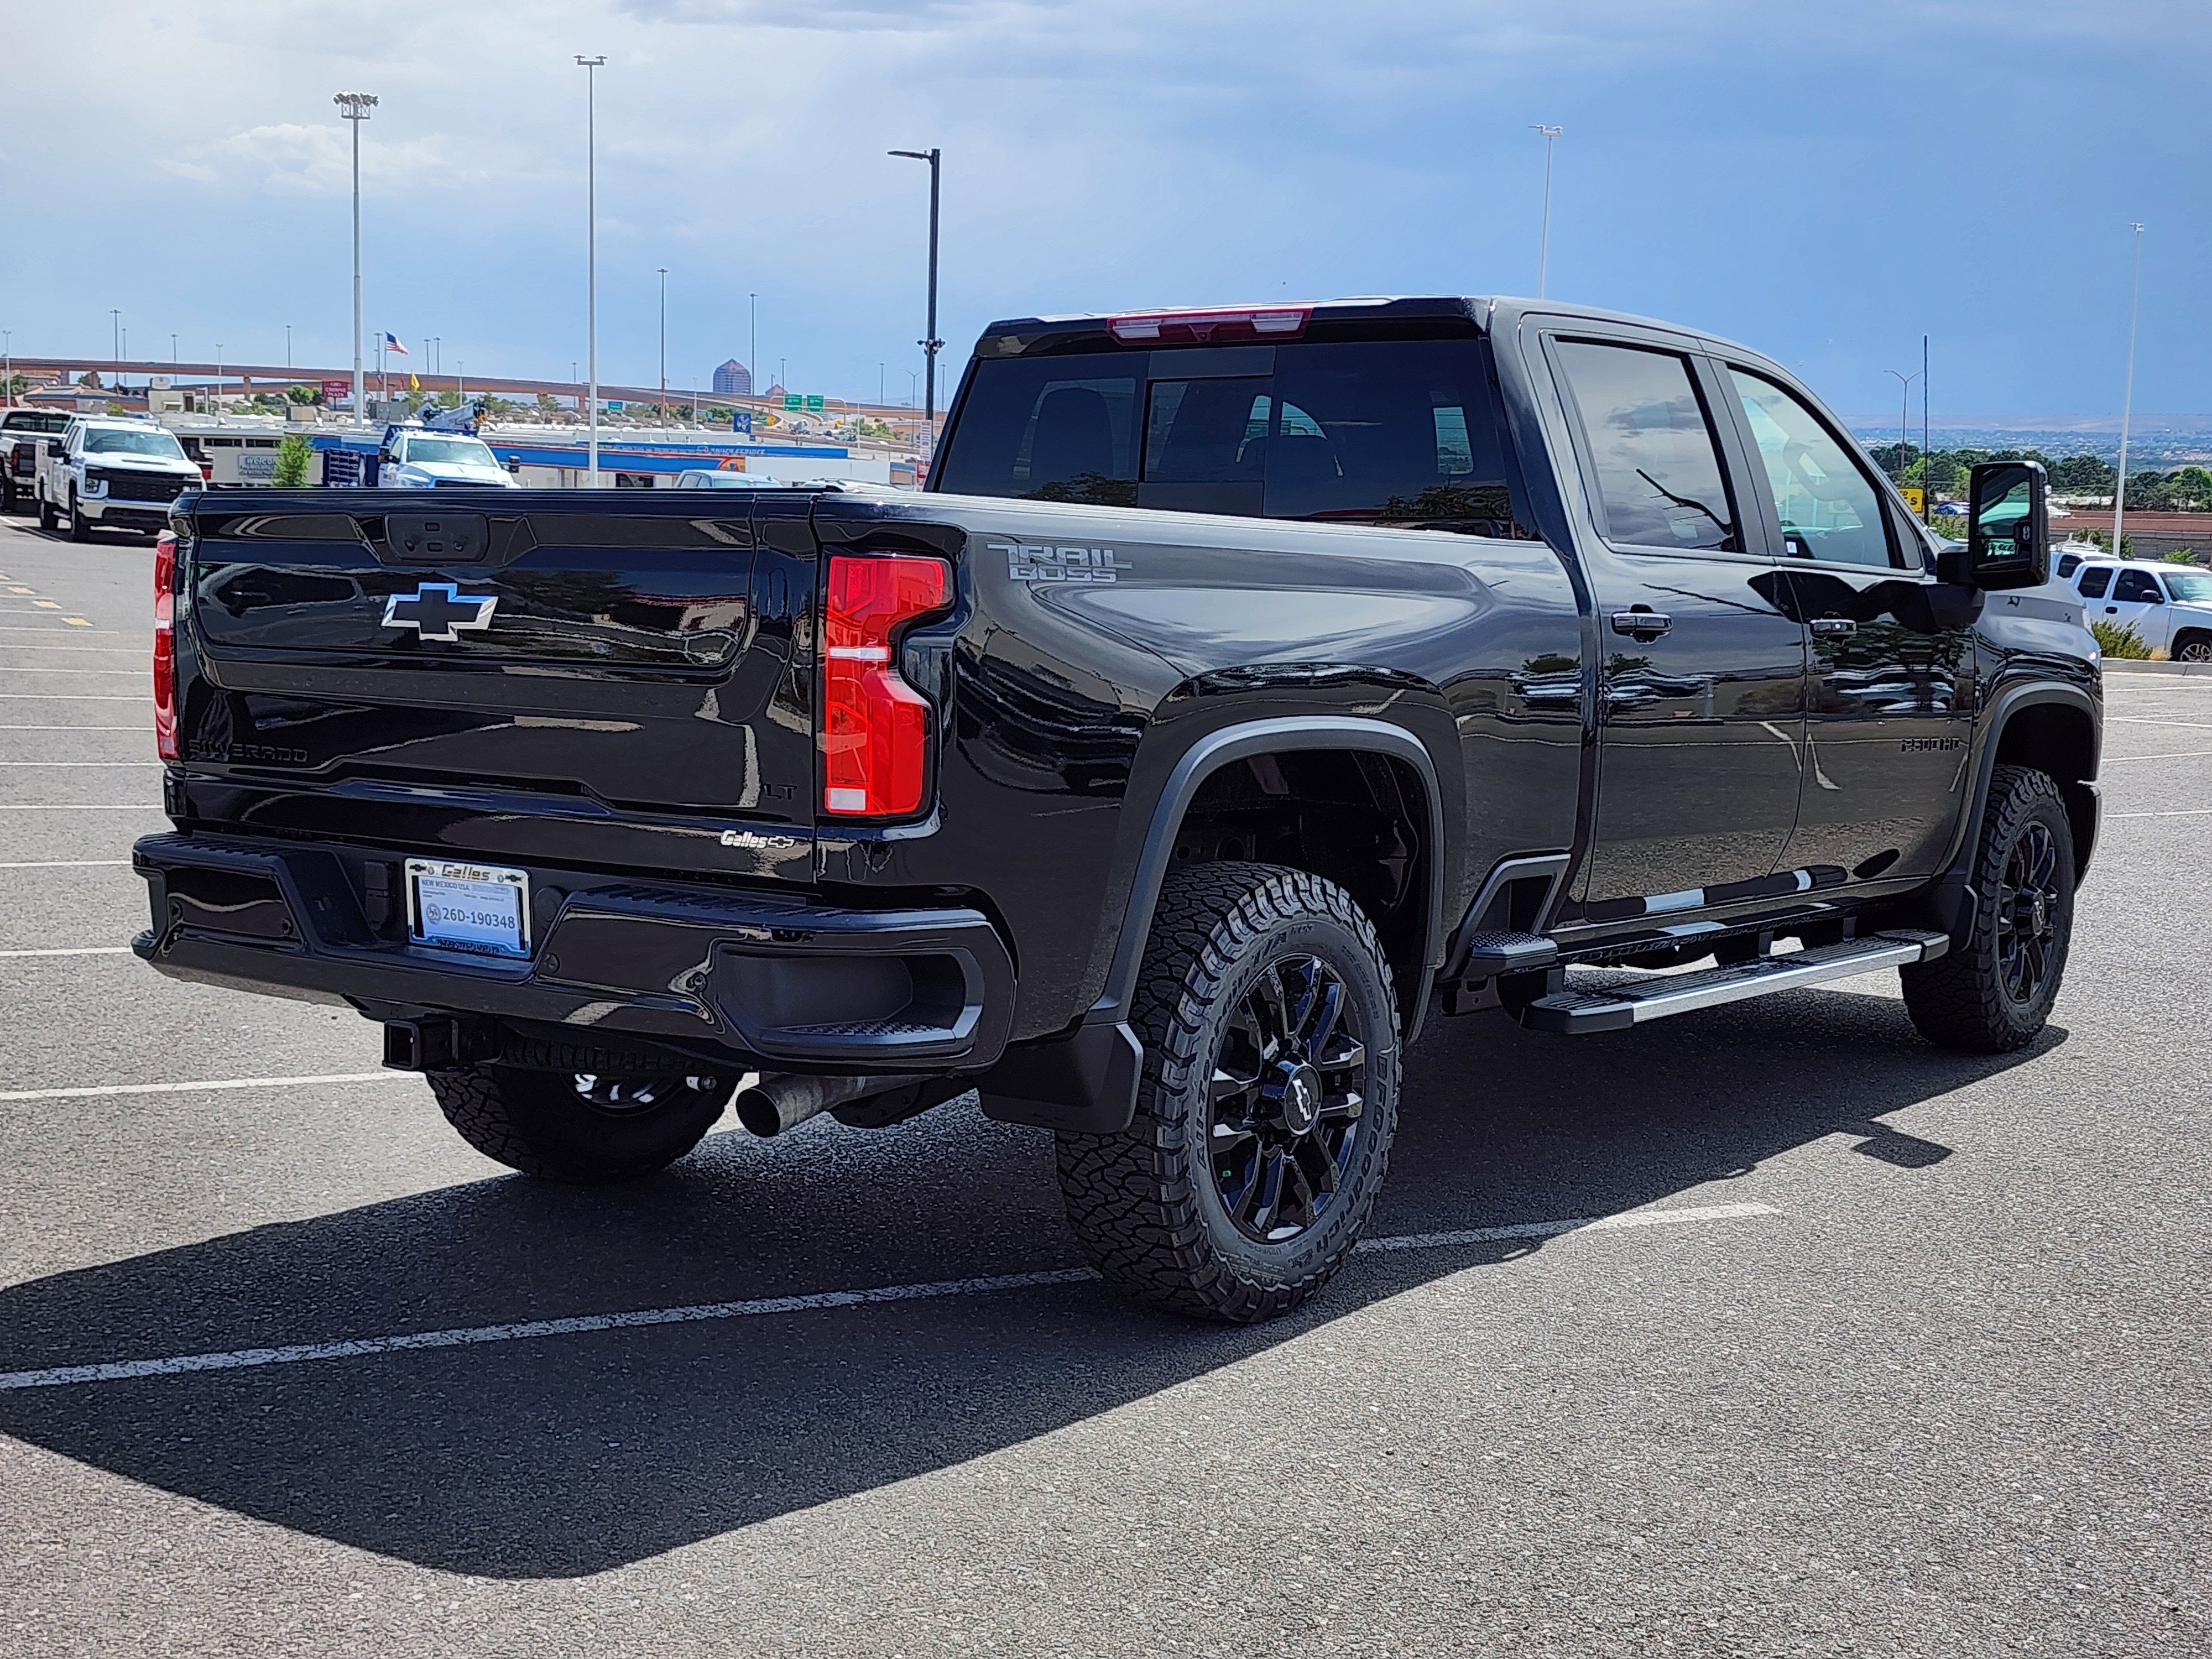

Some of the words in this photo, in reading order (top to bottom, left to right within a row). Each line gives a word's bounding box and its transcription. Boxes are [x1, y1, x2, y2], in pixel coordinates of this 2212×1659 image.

[986, 542, 1133, 568] TRAIL
[1009, 564, 1117, 582] BOSS
[763, 783, 797, 800] LT
[721, 830, 768, 848] Galles
[442, 864, 491, 880] Galles
[435, 880, 457, 890] MEXICO
[442, 907, 516, 930] 26D-190348
[1316, 1054, 1387, 1253] BFGoodrich
